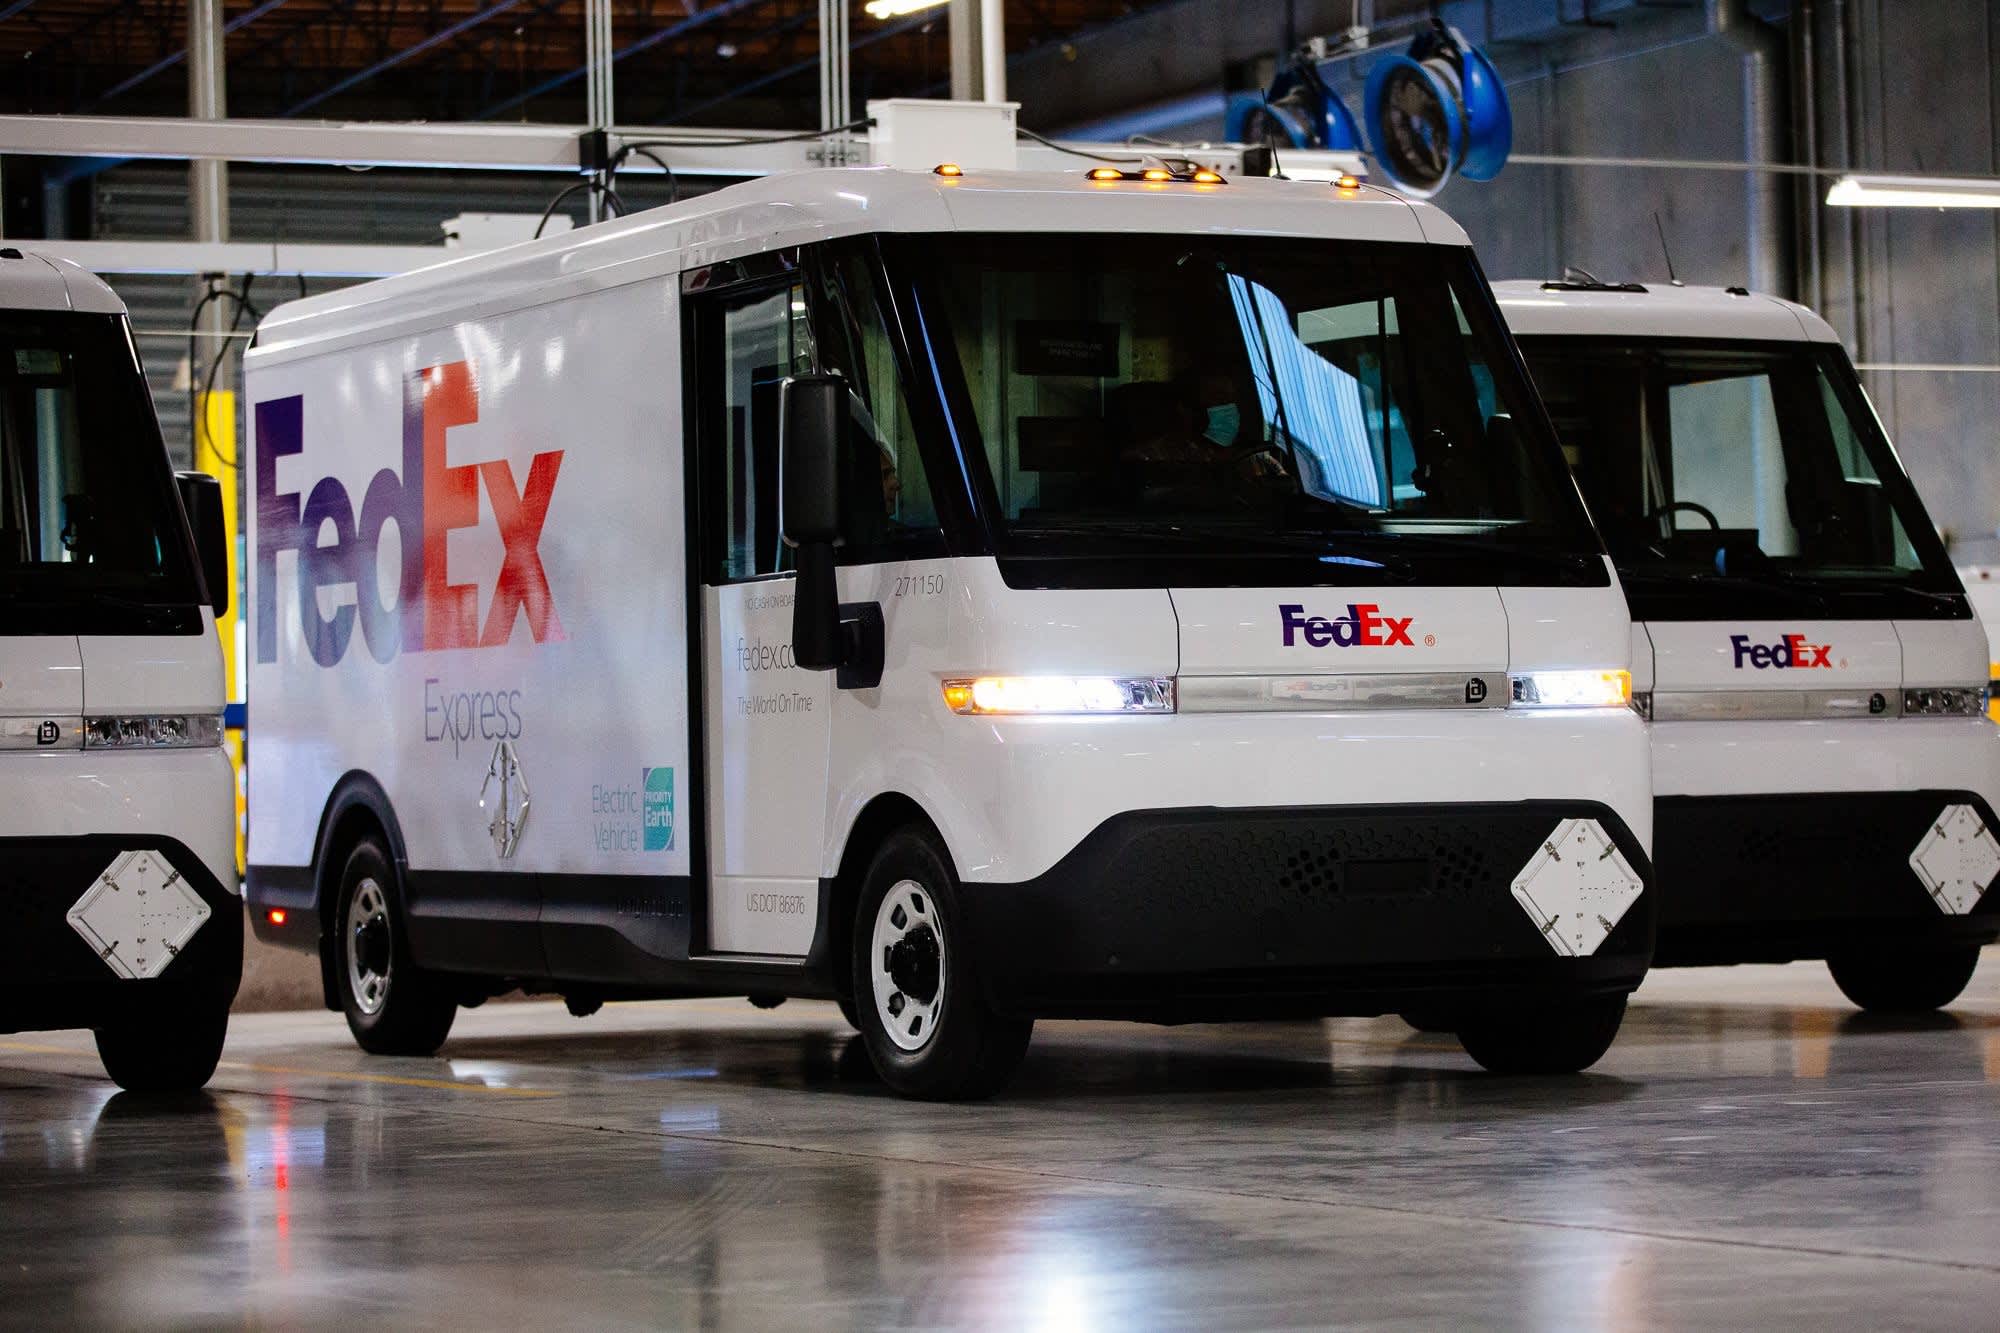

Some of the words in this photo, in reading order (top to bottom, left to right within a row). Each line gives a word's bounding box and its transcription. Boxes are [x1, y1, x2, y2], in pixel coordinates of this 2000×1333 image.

[255, 360, 566, 668] FedEx
[896, 574, 943, 597] 271150
[770, 594, 779, 608] ON
[1279, 604, 1415, 648] FedEx
[1730, 634, 1832, 669] FedEx
[737, 696, 751, 715] The
[752, 693, 777, 714] World
[778, 692, 791, 713] On
[792, 692, 813, 712] Time
[424, 679, 522, 760] Express
[592, 783, 638, 813] Electric
[645, 804, 672, 827] Earth
[593, 821, 638, 851] Vehicle
[746, 893, 759, 912] US
[759, 894, 778, 913] DOT
[779, 895, 805, 914] 86876
